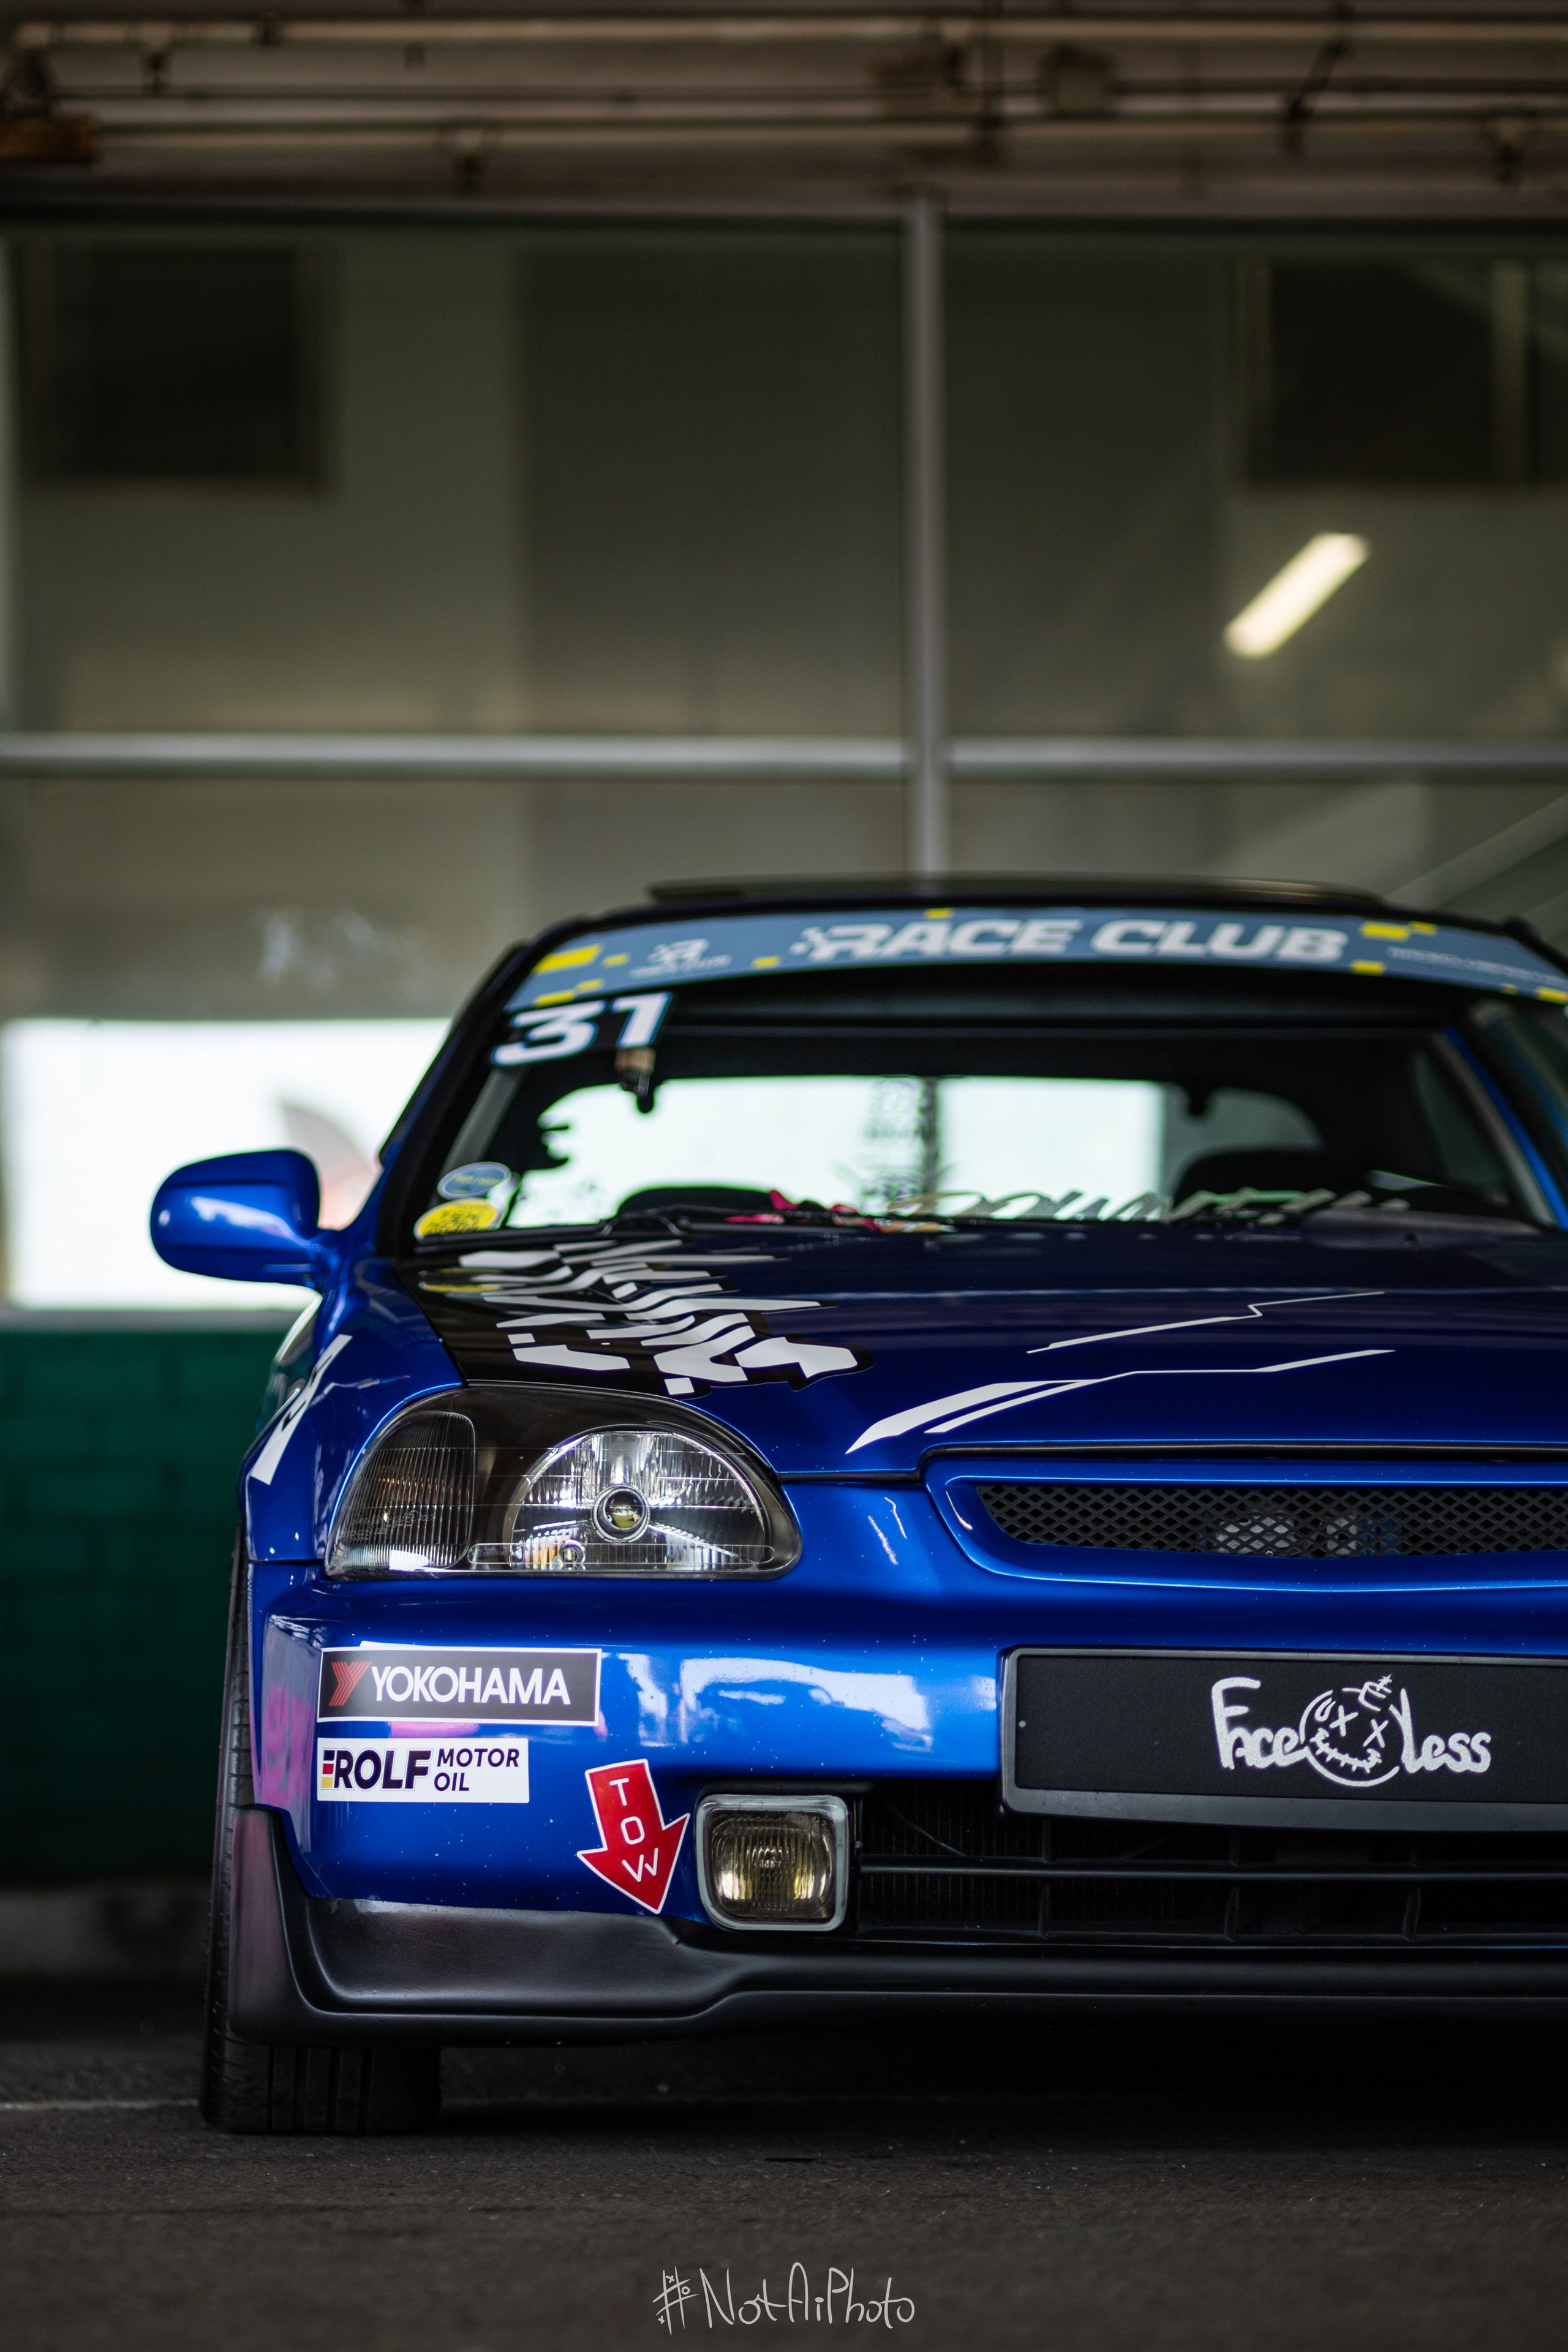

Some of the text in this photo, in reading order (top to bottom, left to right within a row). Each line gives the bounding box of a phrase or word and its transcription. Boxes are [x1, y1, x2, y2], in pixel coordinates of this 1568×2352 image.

[790, 919, 1345, 962] RACE CLUB
[492, 991, 671, 1066] 31
[372, 1665, 571, 1705] YOKOHAMA
[334, 1749, 431, 1790] ROLF
[437, 1748, 519, 1767] MOTOR
[434, 1773, 470, 1791] OIL
[609, 1778, 658, 1882] TOW
